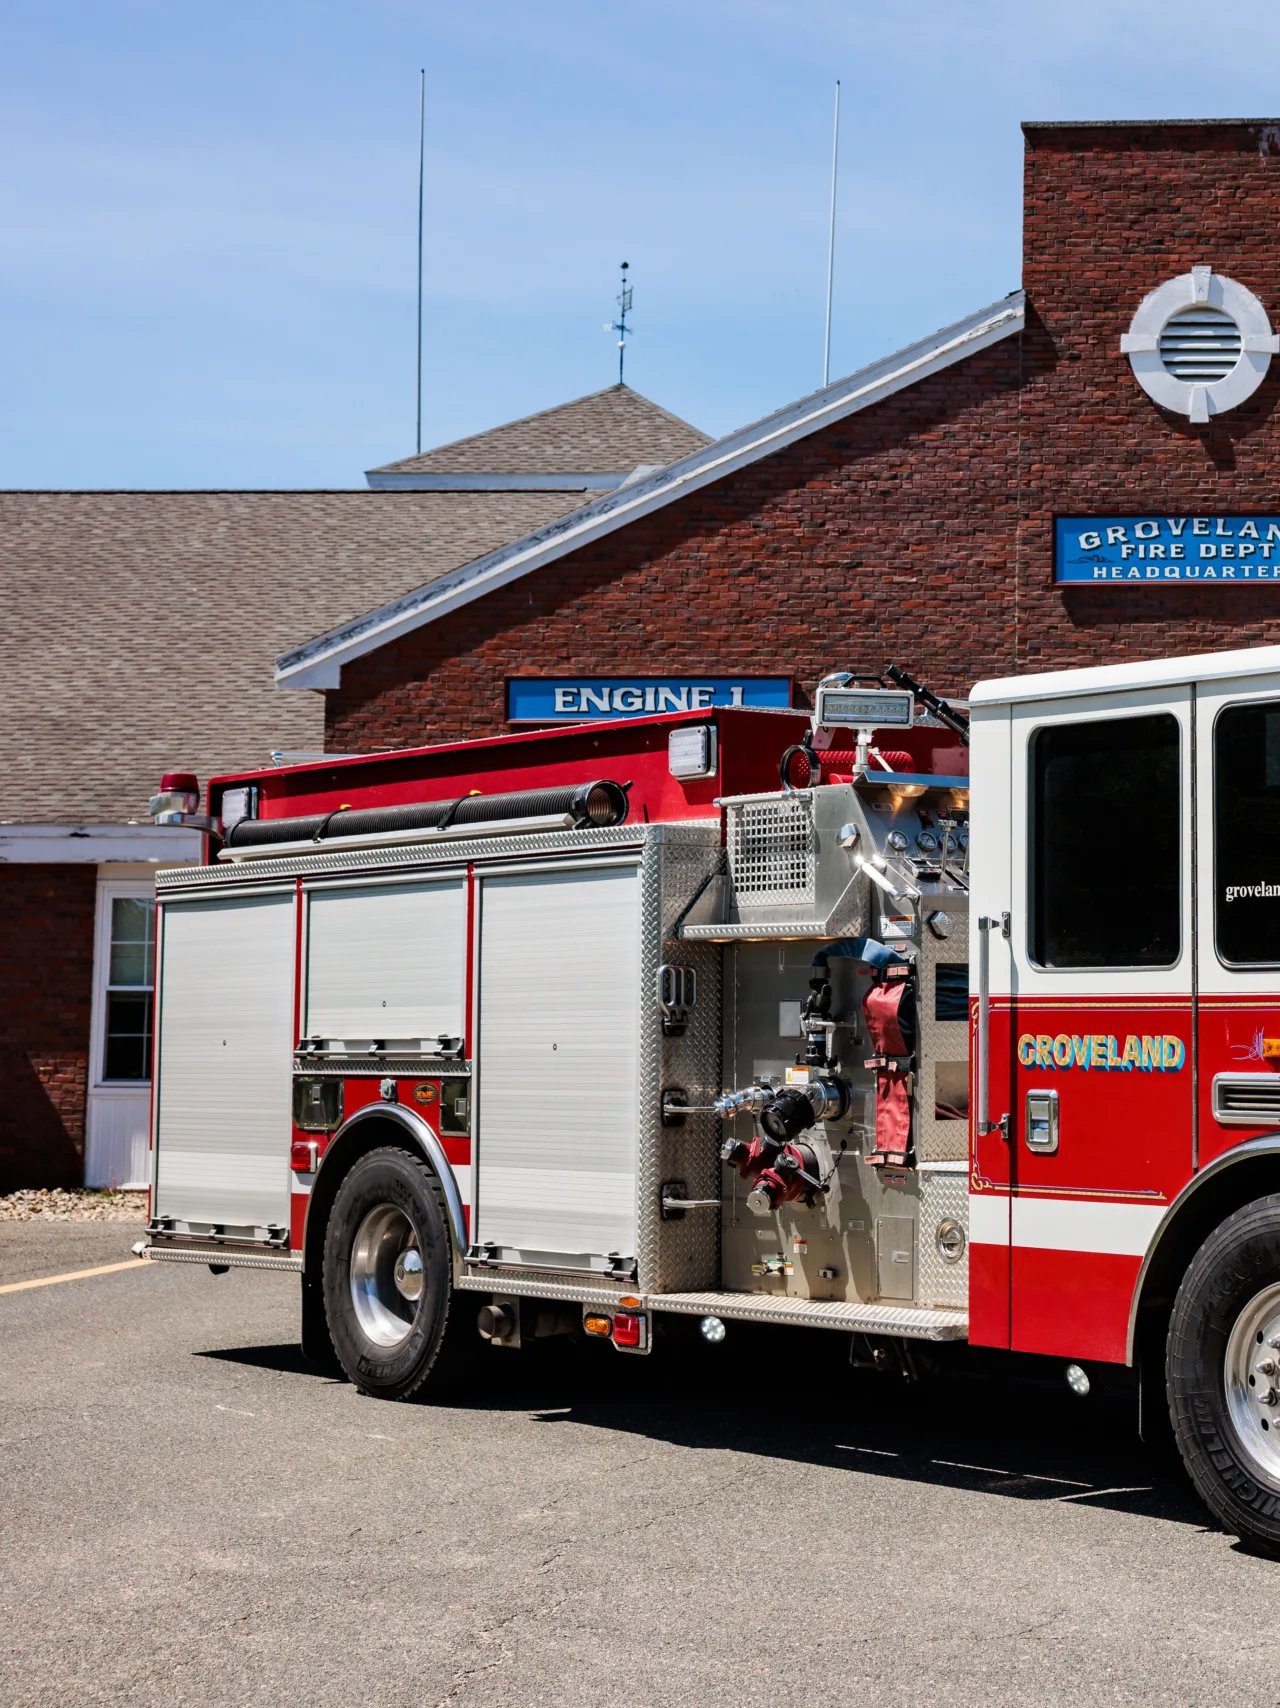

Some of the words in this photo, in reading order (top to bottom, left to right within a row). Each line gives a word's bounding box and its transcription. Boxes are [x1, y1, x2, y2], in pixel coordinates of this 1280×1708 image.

[1121, 543, 1185, 560] FIRE
[1200, 543, 1275, 560] DEPT
[554, 686, 715, 713] ENGINE
[730, 686, 744, 706] 1
[1017, 1033, 1186, 1073] GROVELAND
